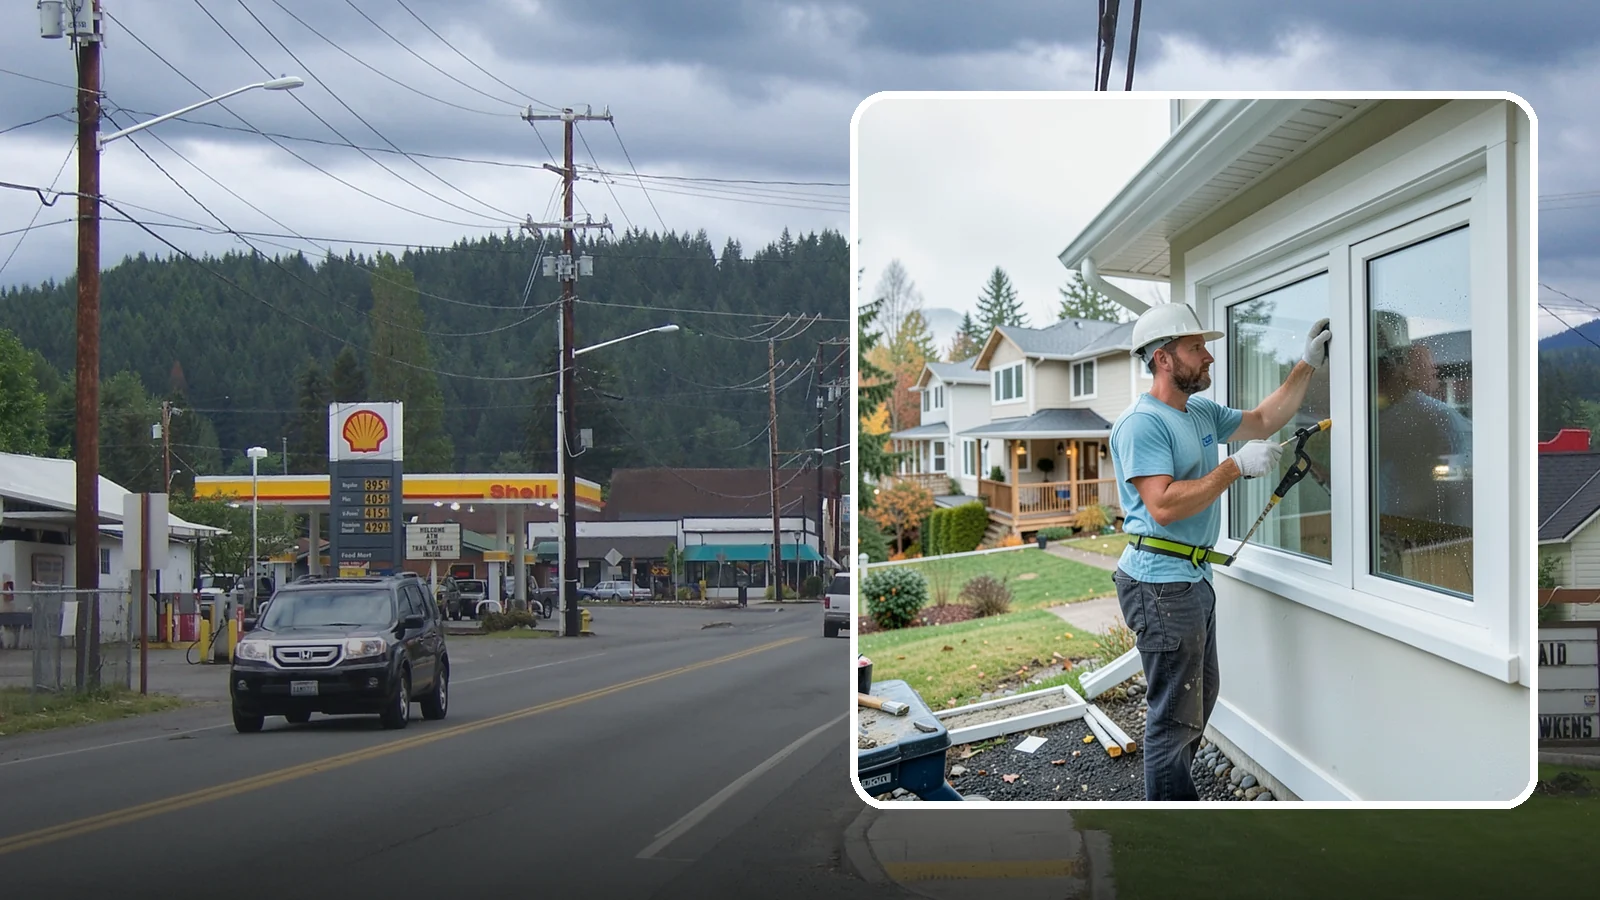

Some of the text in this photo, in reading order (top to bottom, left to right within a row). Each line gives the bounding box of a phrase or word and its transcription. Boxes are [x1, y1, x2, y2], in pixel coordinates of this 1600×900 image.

[366, 480, 384, 490] 395
[490, 484, 547, 499] Shell
[366, 494, 384, 504] 405
[366, 508, 384, 518] 415
[366, 522, 384, 532] 429
